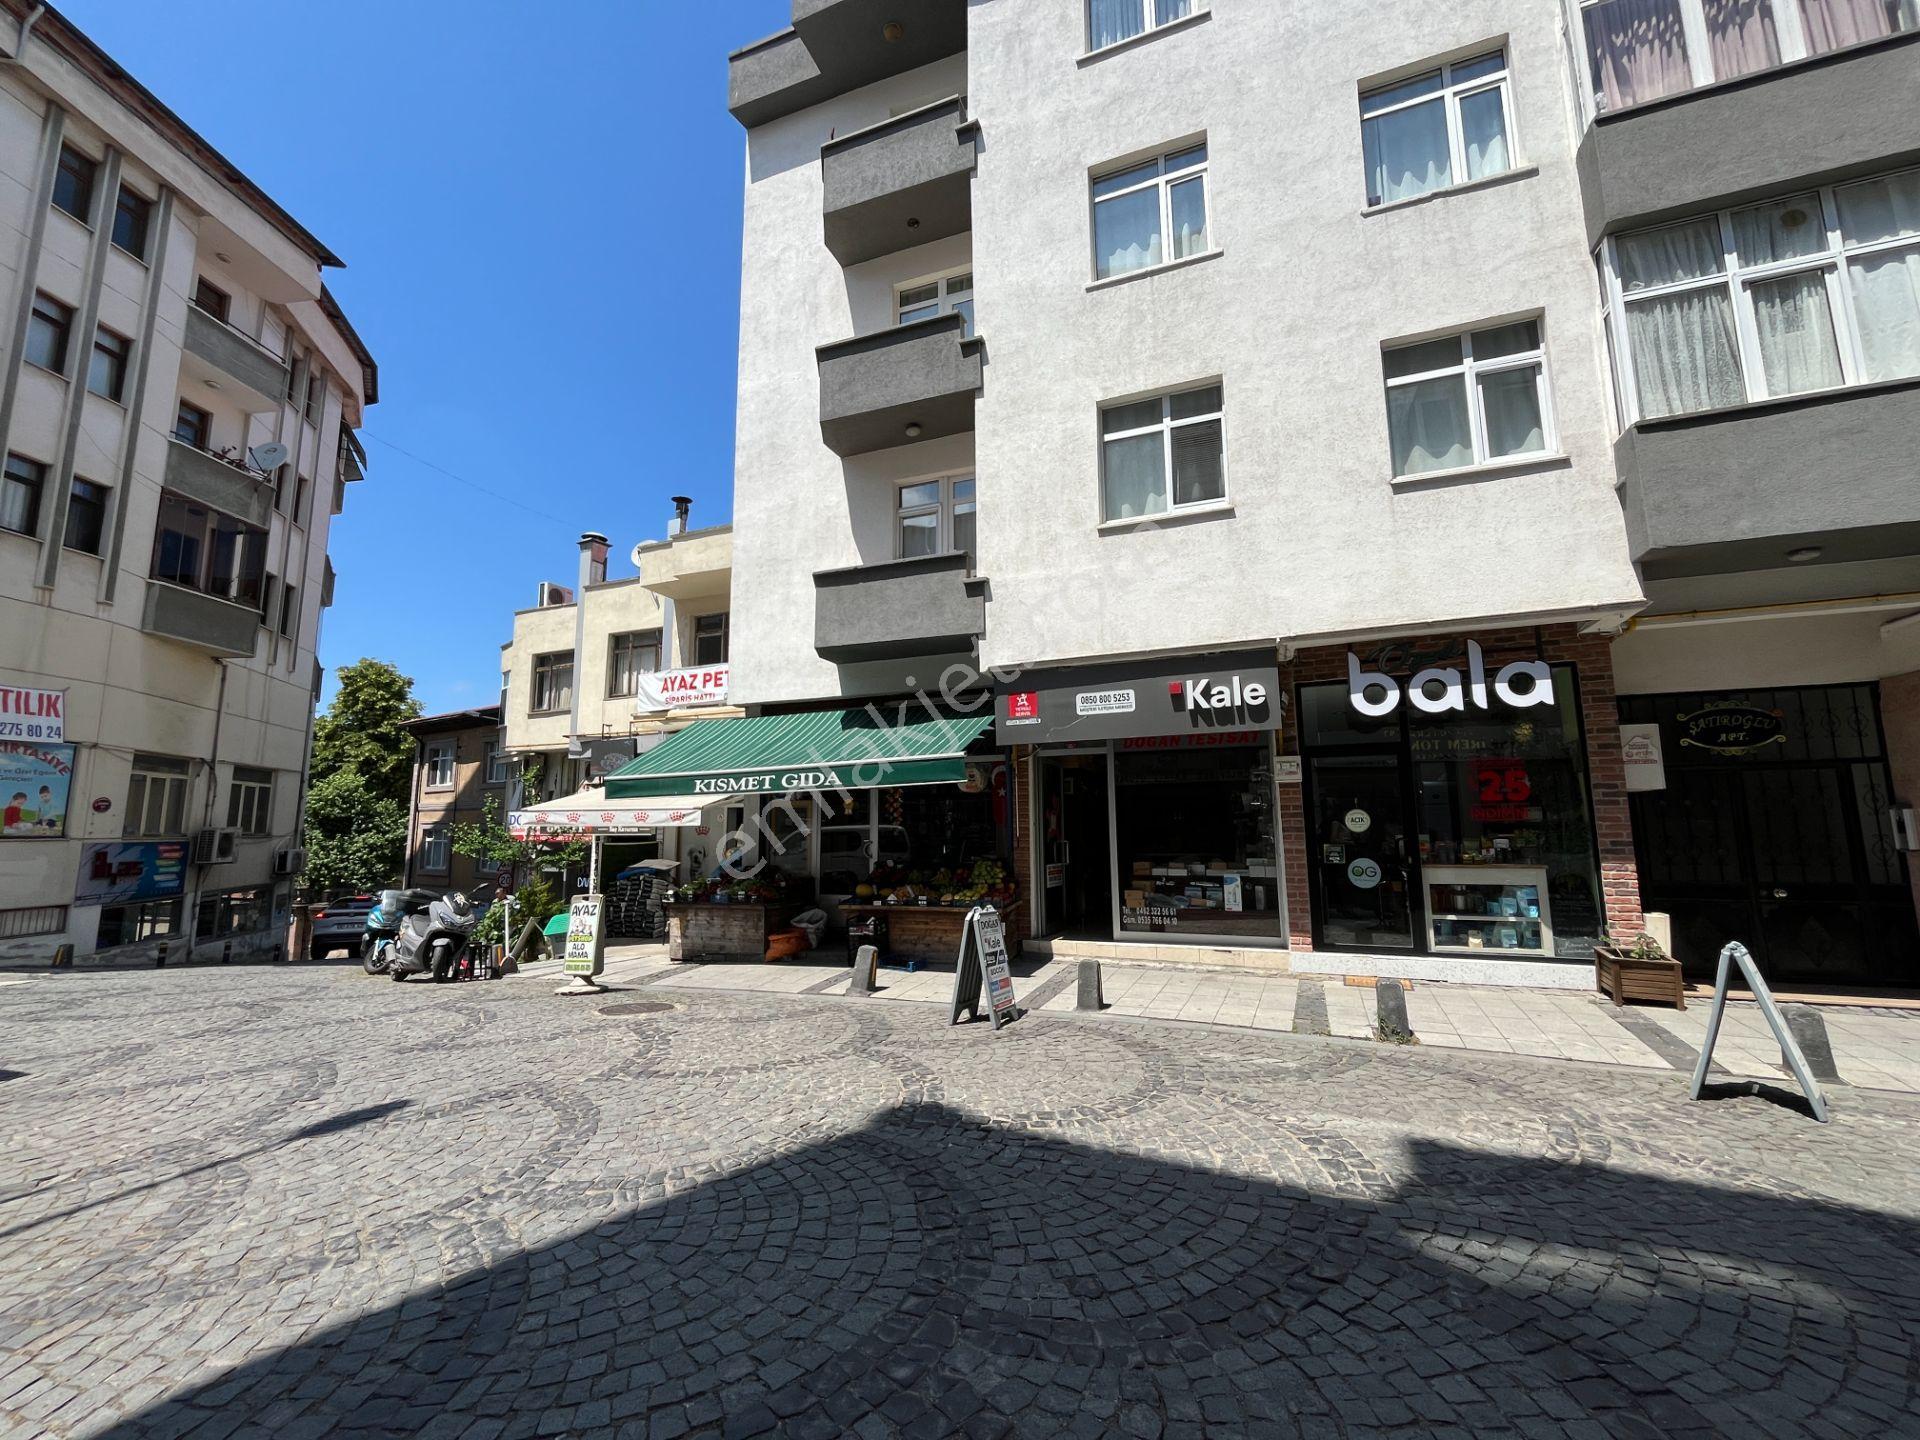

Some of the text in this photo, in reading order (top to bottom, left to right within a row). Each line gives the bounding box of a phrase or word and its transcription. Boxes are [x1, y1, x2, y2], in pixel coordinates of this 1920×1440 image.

[661, 673, 698, 694] AYAZ
[1347, 639, 1555, 716] bala
[0, 688, 60, 718] TILIK
[1080, 692, 1131, 705] 0850 800 5253
[1185, 676, 1267, 710] Kale
[27, 724, 42, 738] 80
[46, 726, 61, 739] 24
[694, 771, 843, 793] KISMET GIDA
[1478, 769, 1531, 802] 25
[572, 904, 597, 917] AYAZ
[572, 943, 585, 951] ALO
